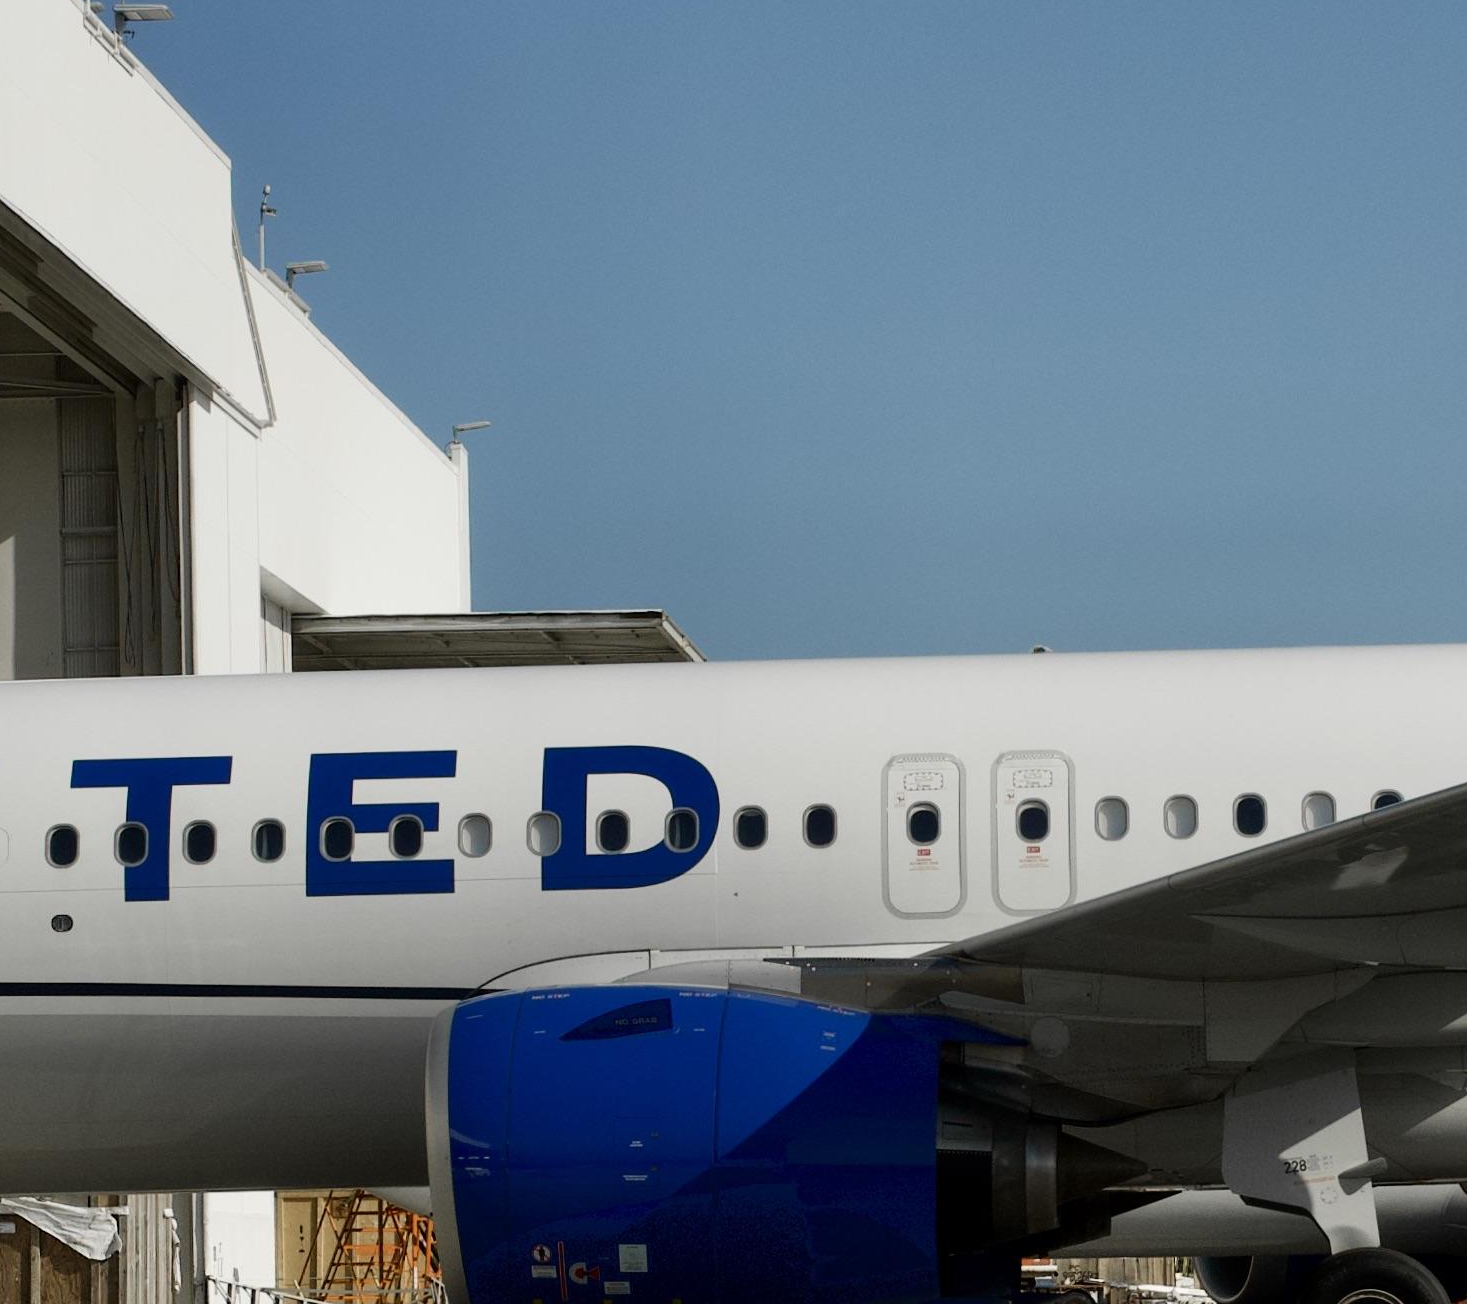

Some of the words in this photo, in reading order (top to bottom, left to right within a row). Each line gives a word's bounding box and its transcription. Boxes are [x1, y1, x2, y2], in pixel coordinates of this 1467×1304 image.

[615, 1018, 628, 1026] NO
[632, 1016, 657, 1025] GRAB
[1284, 1159, 1307, 1174] 228
